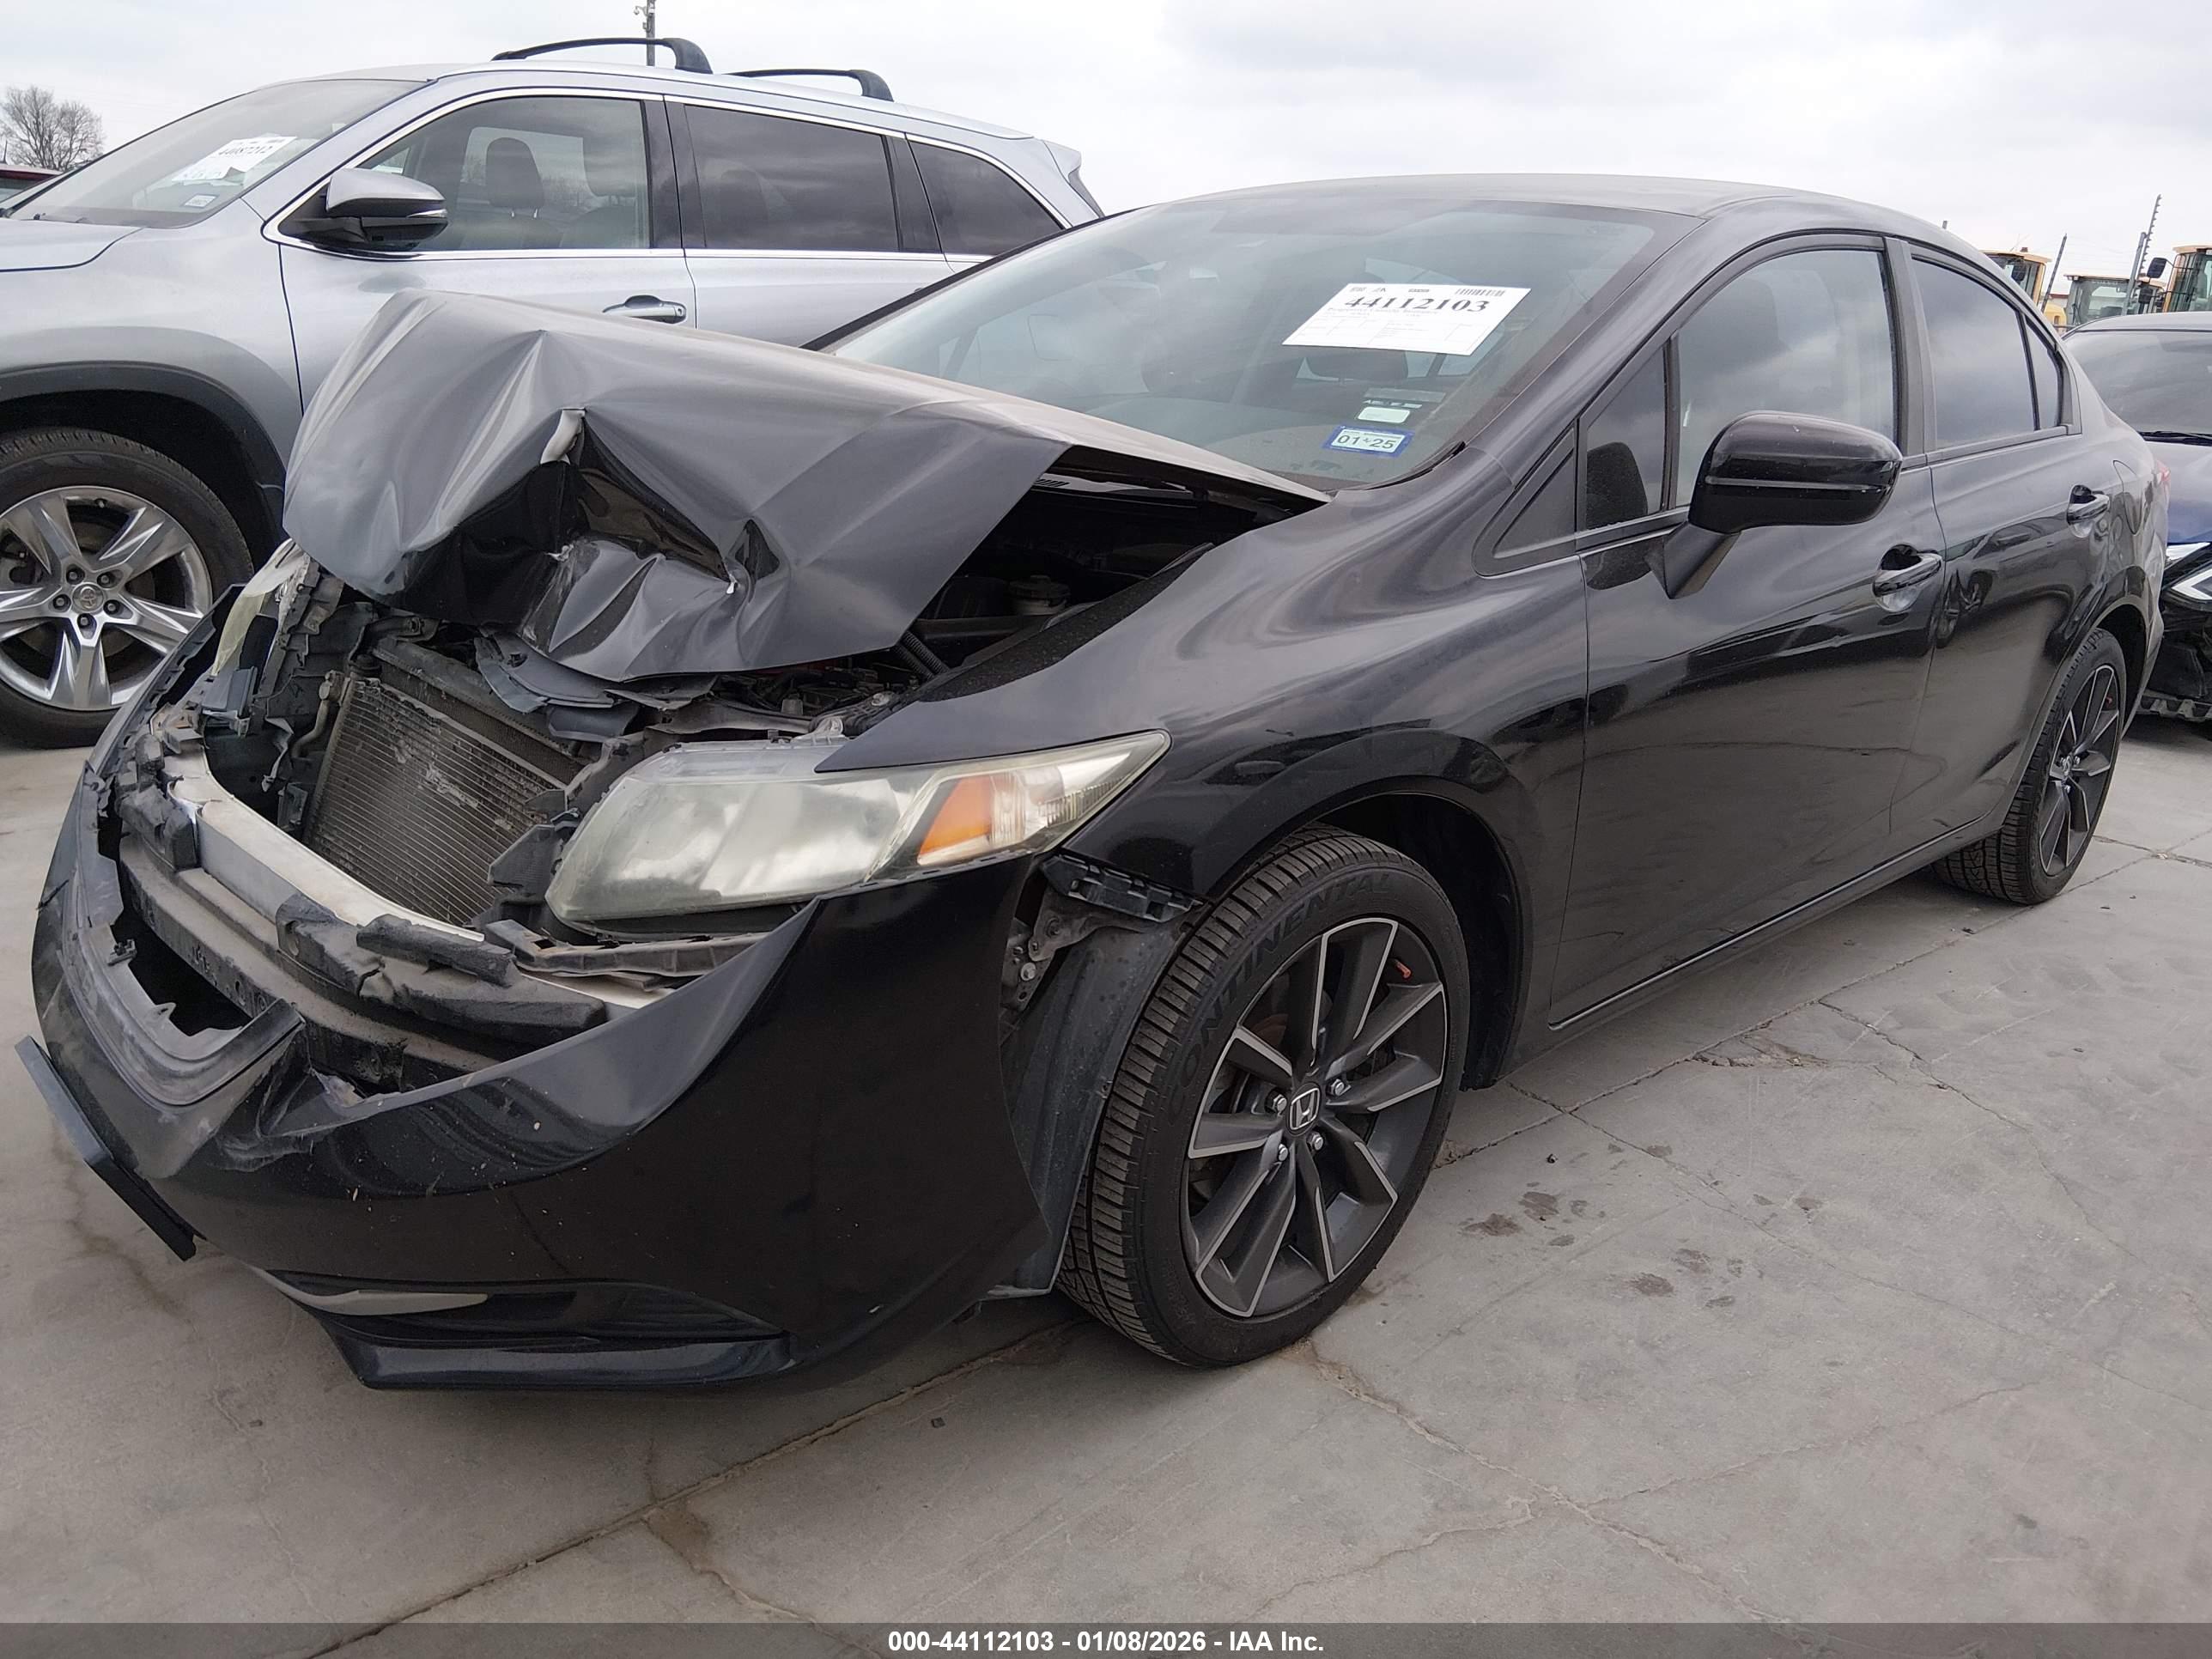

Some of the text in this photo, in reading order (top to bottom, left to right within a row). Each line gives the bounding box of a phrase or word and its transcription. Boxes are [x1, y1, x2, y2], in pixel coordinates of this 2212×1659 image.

[1345, 295, 1491, 313] 44112103
[1337, 434, 1397, 449] 01 25
